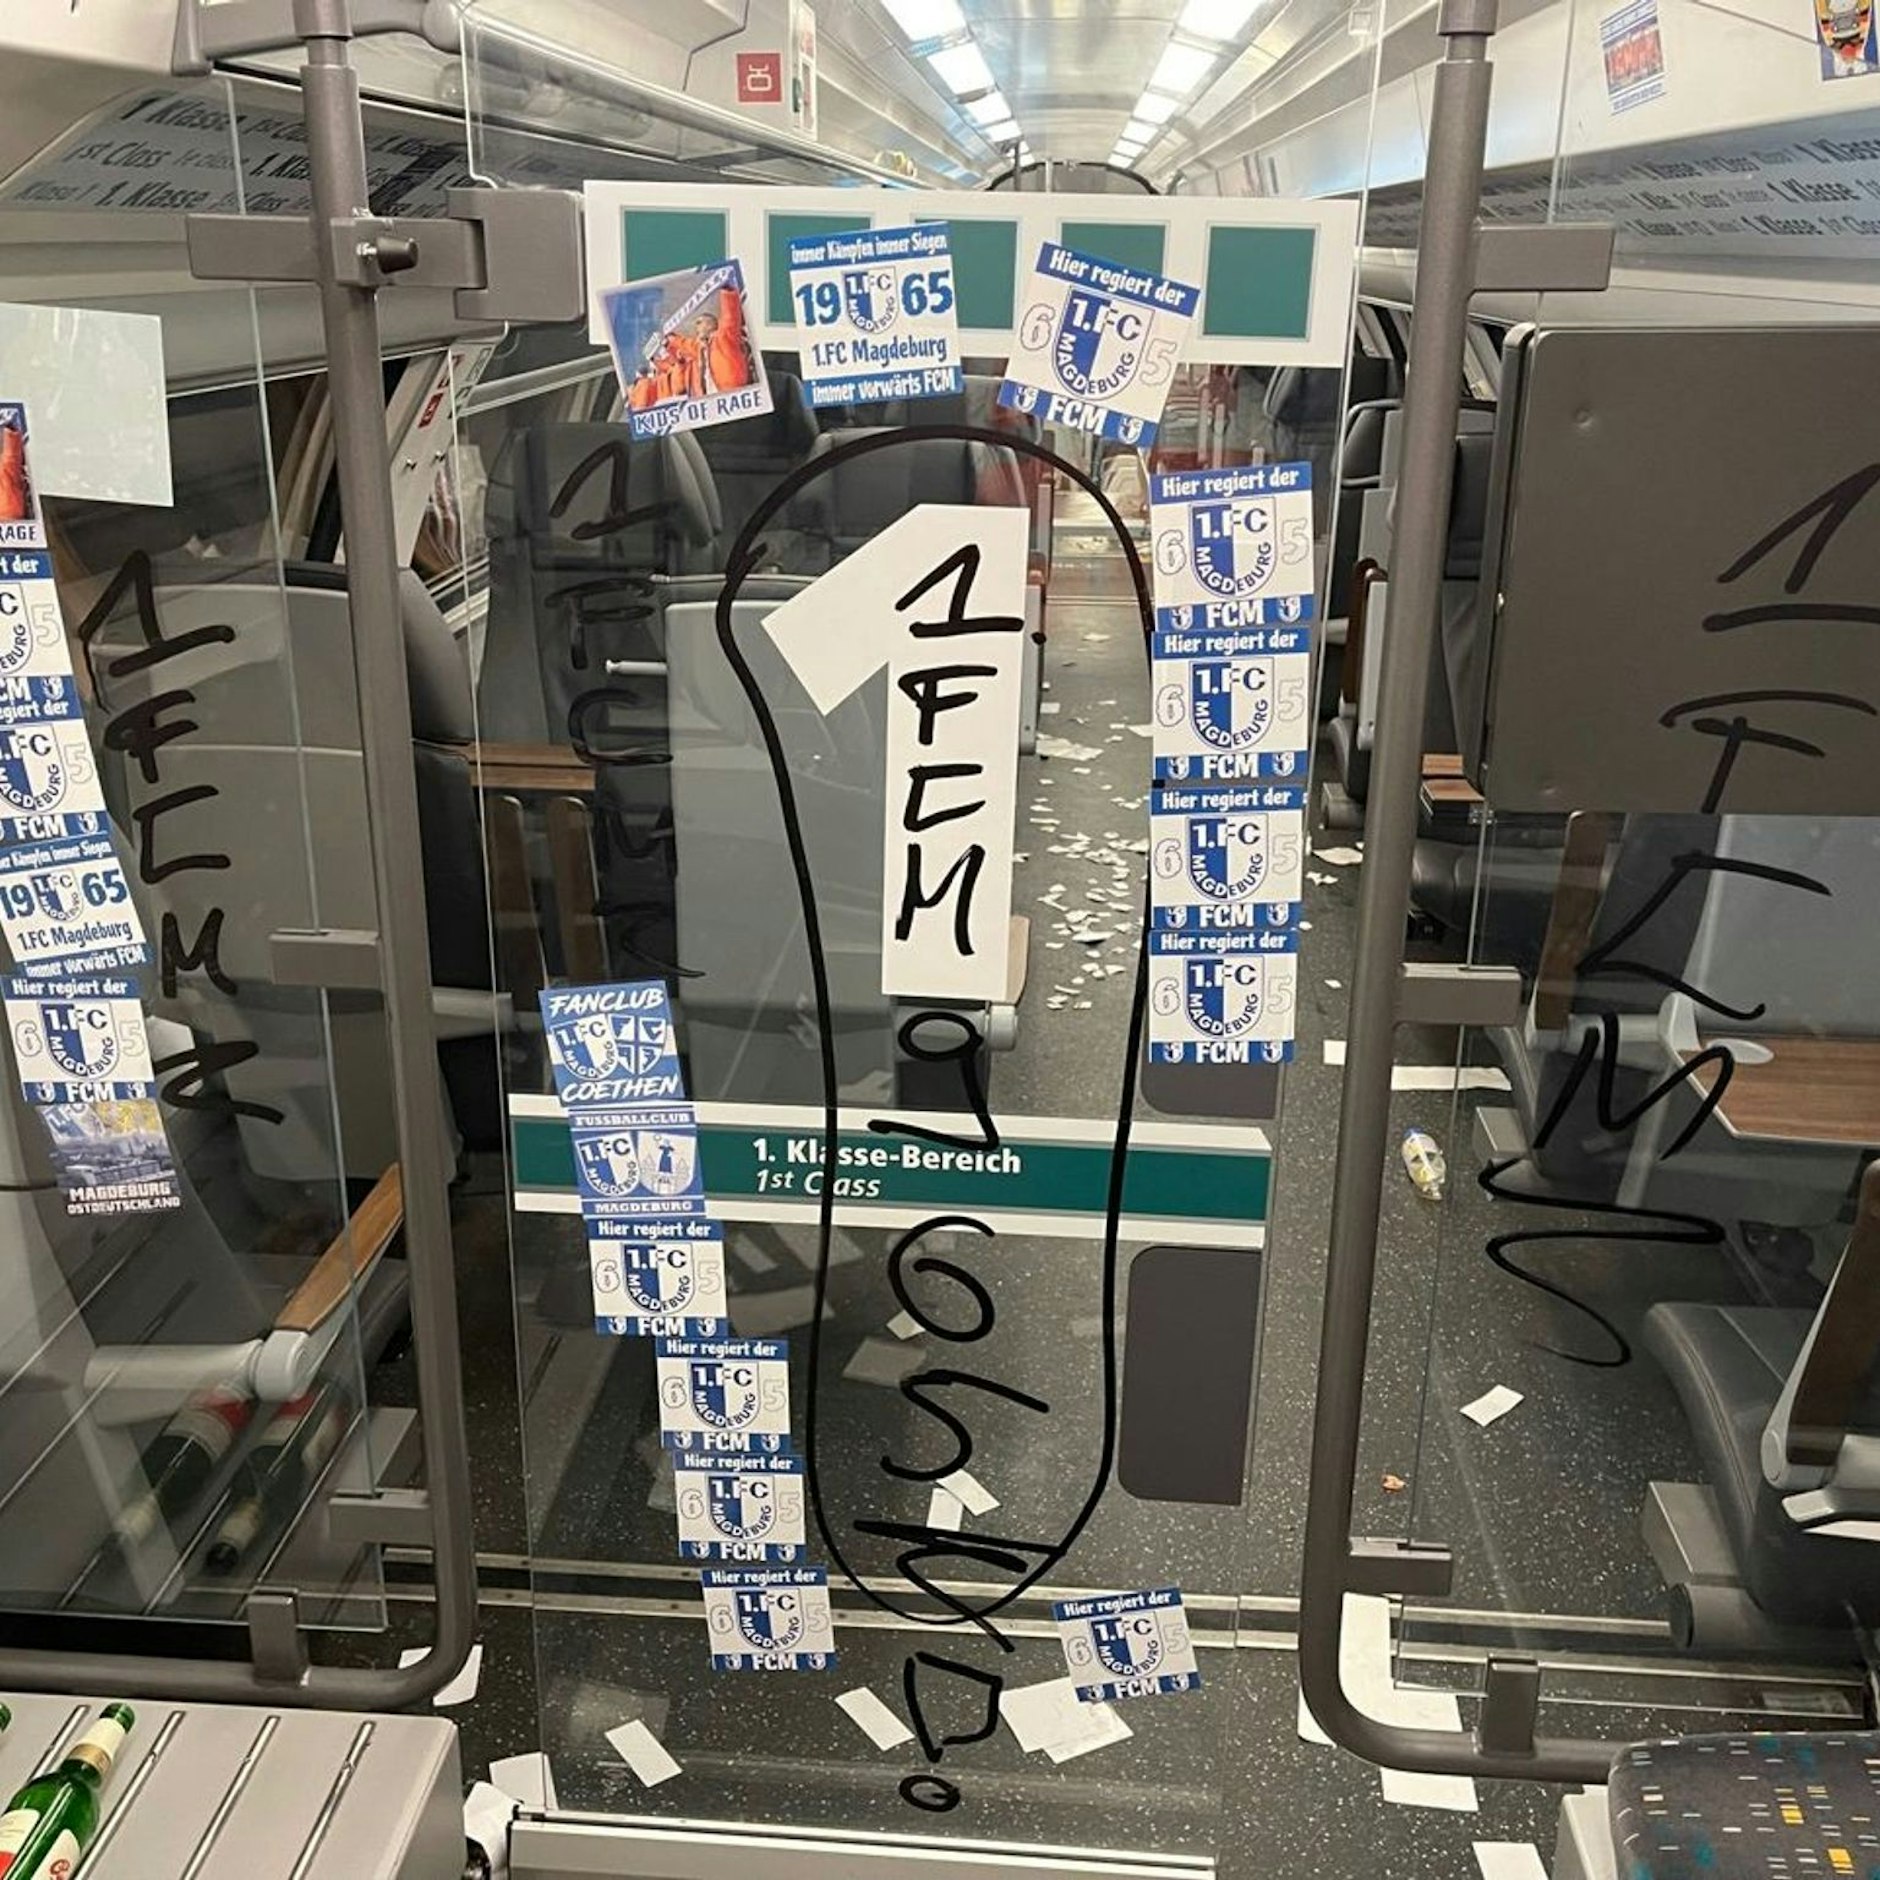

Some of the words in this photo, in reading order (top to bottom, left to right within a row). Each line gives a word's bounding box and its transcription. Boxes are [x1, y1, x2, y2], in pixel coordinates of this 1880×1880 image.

[911, 231, 947, 256] Siegen
[1049, 249, 1089, 279] Hier
[1091, 265, 1153, 297] regiert
[1155, 281, 1186, 306] der
[796, 282, 841, 326] 19
[902, 270, 954, 316] 65
[812, 341, 848, 366] 1.FC
[852, 335, 947, 367] Magdeburg
[1057, 332, 1135, 395] MAGDEBURG
[858, 373, 922, 400] vorwärts
[924, 368, 955, 394] FCM
[634, 407, 680, 434] KIDS
[688, 403, 709, 421] OF
[717, 391, 762, 415] RAGE
[1046, 396, 1107, 435] FCM
[1162, 475, 1197, 498] Hier
[1204, 471, 1265, 497] regiert
[1269, 468, 1299, 487] der
[0, 525, 37, 543] AGE
[12, 555, 39, 574] der
[1196, 541, 1272, 595] MAGDEBURG
[1206, 600, 1265, 628] FCM
[1164, 635, 1202, 653] Hier
[1205, 633, 1265, 655] regiert
[1269, 631, 1298, 648] der
[43, 700, 69, 716] der
[1195, 700, 1268, 746] MAGDEBURG
[1203, 753, 1259, 778] FCM
[1162, 793, 1197, 810] Hier
[1202, 791, 1260, 813] regiert
[1263, 790, 1291, 805] der
[13, 813, 69, 840] FCM
[1191, 853, 1263, 896] MAGDEBURG
[82, 869, 127, 906] 65
[1200, 905, 1254, 927] FCM
[17, 929, 49, 951] 1.FC
[50, 922, 132, 948] Magdeburg
[1160, 934, 1196, 950] Hier
[1199, 932, 1256, 953] regiert
[1259, 931, 1287, 947] der
[117, 944, 146, 965] FCM
[12, 979, 46, 995] Hier
[49, 979, 99, 998] regiert
[102, 978, 128, 995] der
[549, 988, 664, 1018] FANCLUB
[1189, 993, 1258, 1035] MAGDEBURG
[1195, 1042, 1250, 1064] FCM
[66, 1083, 116, 1102] FCM
[561, 1074, 679, 1102] COETHEN
[575, 1112, 690, 1126] FUSSBALLCLUB
[753, 1138, 776, 1162] 1.
[69, 1181, 171, 1201] MAGDEBURG
[756, 1169, 793, 1192] 1st
[804, 1171, 880, 1198] Cass
[67, 1197, 181, 1214] OSTDEUTSCHLAND
[595, 1201, 692, 1213] MAGDEBURG
[597, 1220, 631, 1237] Hier
[633, 1220, 684, 1240] regiert
[688, 1220, 711, 1237] der
[637, 1318, 686, 1337] FCM
[666, 1341, 697, 1356] Hier
[701, 1341, 749, 1359] regiert
[753, 1340, 777, 1357] der
[703, 1433, 751, 1451] FCM
[684, 1453, 715, 1468] Hier
[717, 1454, 766, 1472] regiert
[768, 1456, 793, 1471] der
[720, 1543, 767, 1562] FCM
[711, 1569, 742, 1584] Hier
[745, 1569, 790, 1588] regiert
[794, 1570, 817, 1583] der
[1063, 1603, 1093, 1617] Hier
[1098, 1595, 1146, 1613] regiert
[1148, 1590, 1172, 1605] der
[752, 1654, 798, 1672] FCM
[1114, 1678, 1162, 1698] FCM
